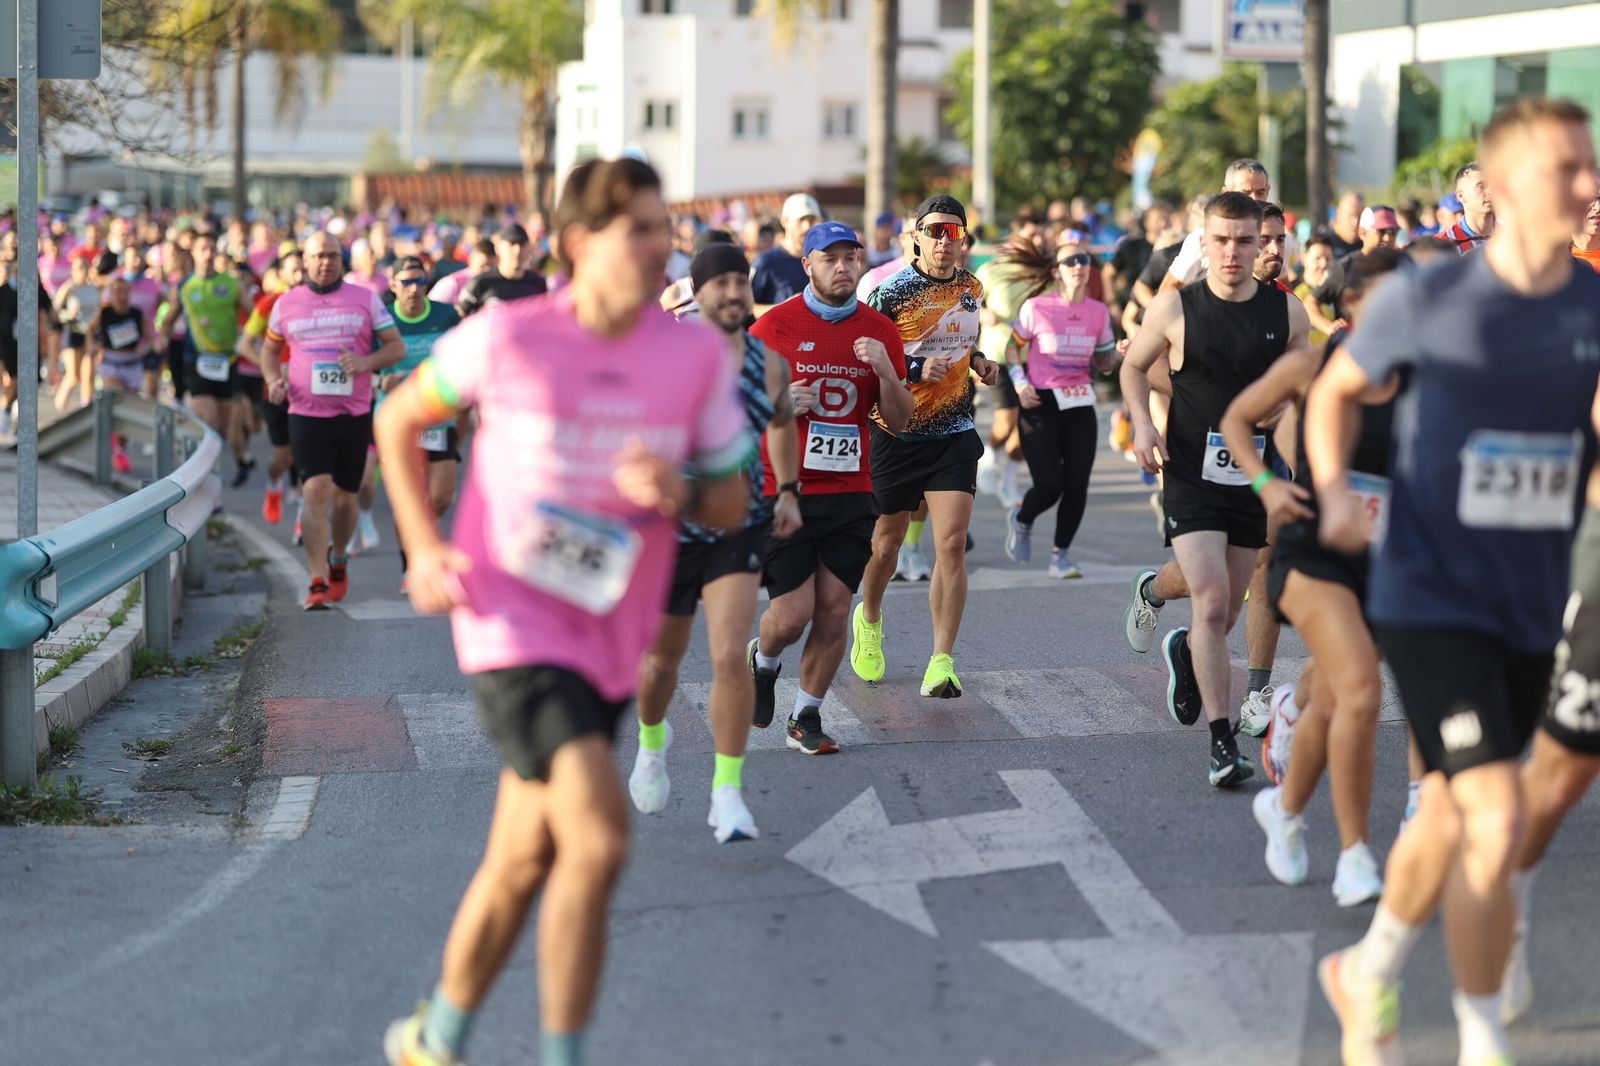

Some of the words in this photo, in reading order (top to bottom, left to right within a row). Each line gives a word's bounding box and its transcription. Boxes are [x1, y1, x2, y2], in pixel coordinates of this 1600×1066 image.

[319, 371, 348, 384] 926
[796, 361, 871, 378] boulanger
[809, 436, 858, 456] 2124
